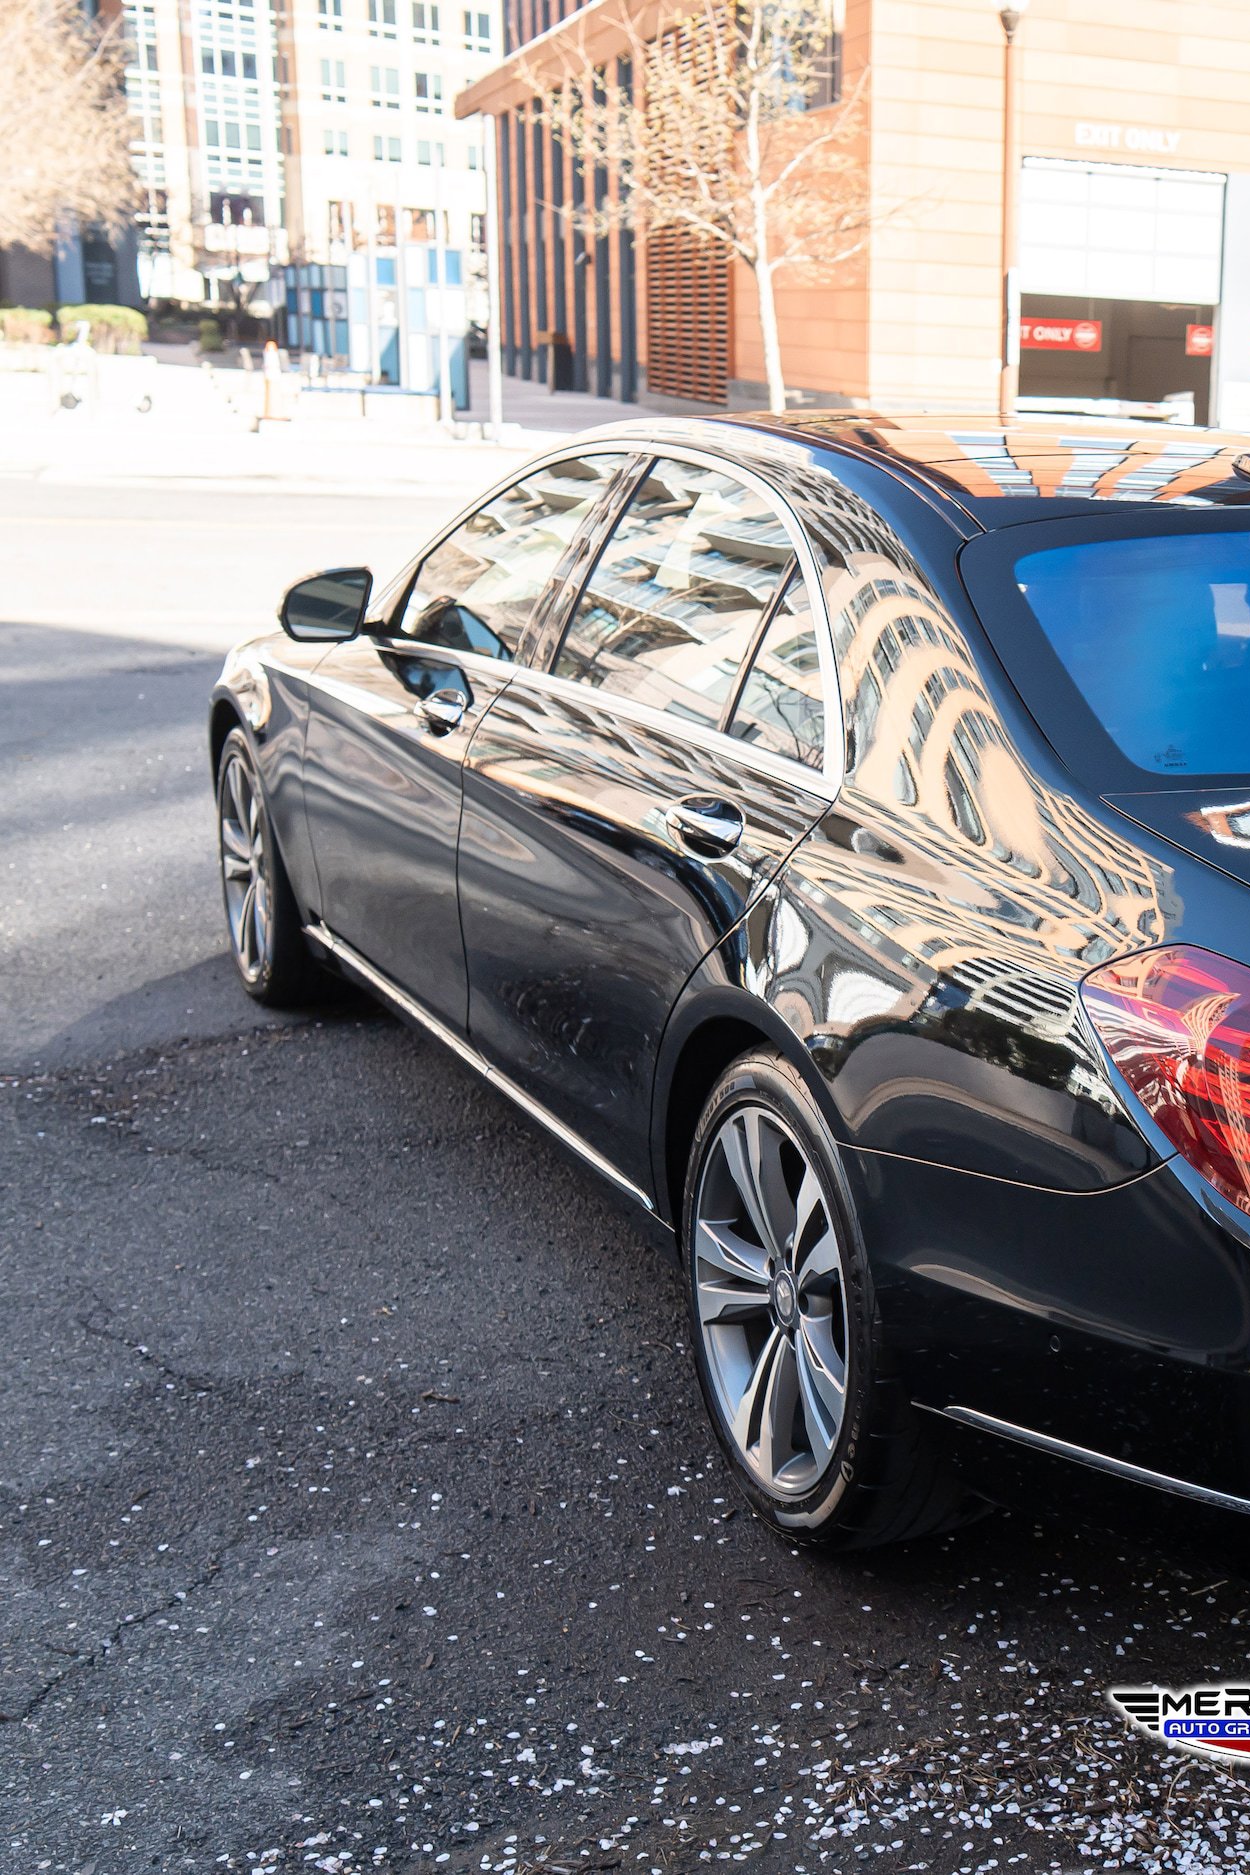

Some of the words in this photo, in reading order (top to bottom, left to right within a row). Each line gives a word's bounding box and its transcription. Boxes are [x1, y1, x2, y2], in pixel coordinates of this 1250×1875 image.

[1075, 122, 1120, 148] EXIT
[1124, 127, 1181, 153] ONLY
[1033, 326, 1073, 341] ONLY
